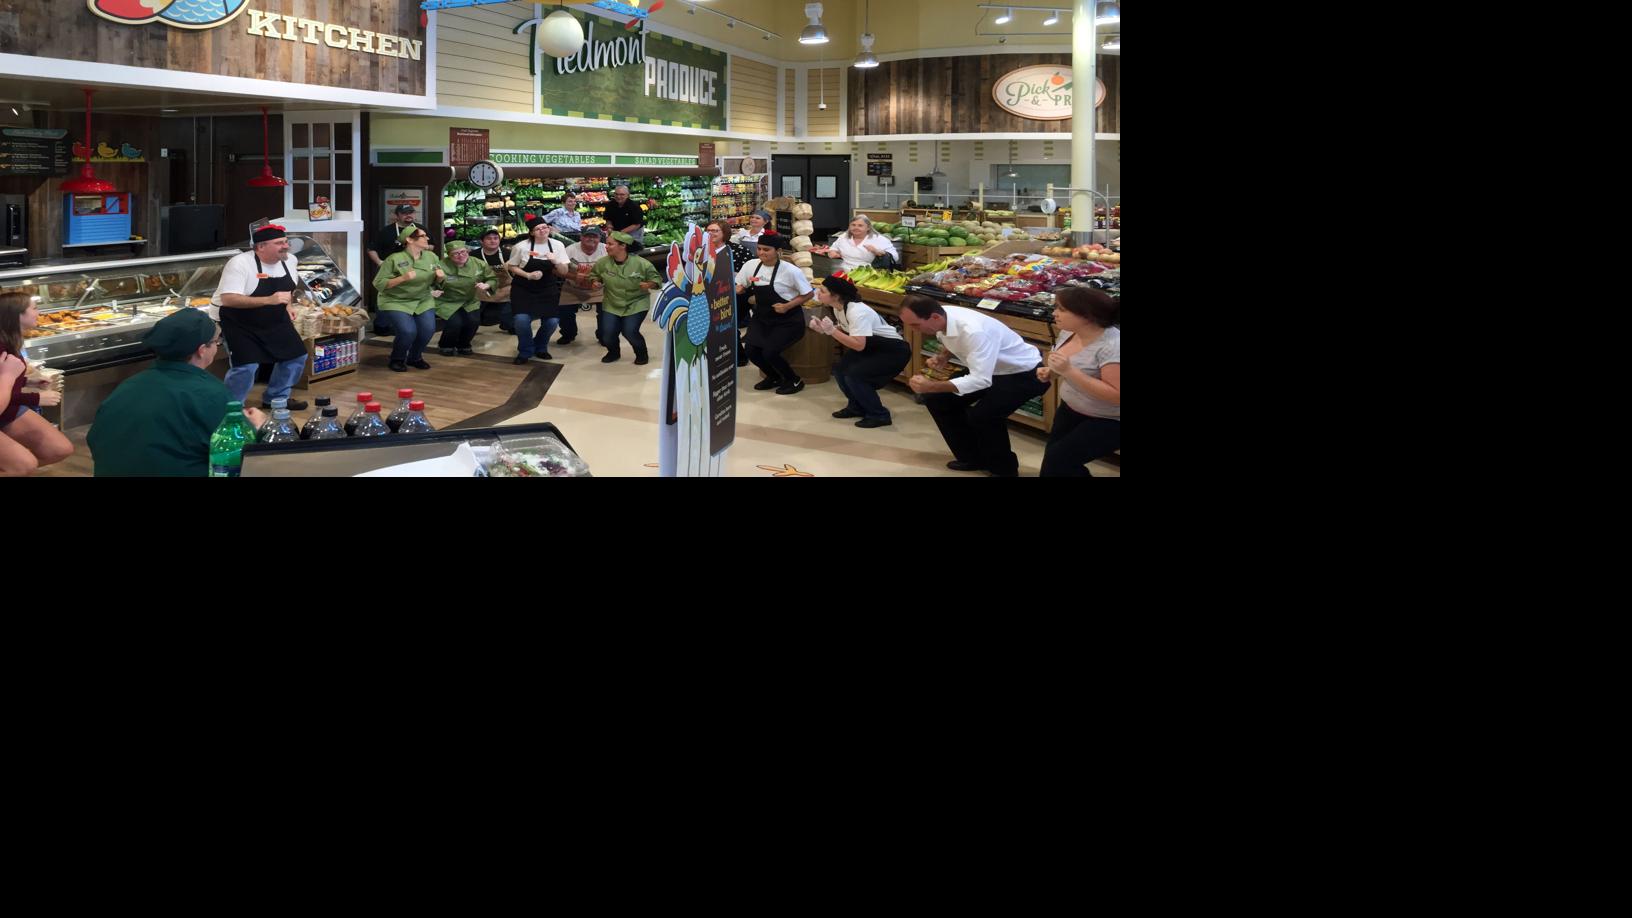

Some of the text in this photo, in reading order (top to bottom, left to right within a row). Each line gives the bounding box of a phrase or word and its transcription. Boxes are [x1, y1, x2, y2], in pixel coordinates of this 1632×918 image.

[247, 8, 423, 61] KITCHEN
[644, 55, 718, 107] PRODUCE
[1005, 79, 1050, 106] Pick
[489, 153, 596, 164] COOKING VEGETABLES
[635, 156, 696, 166] SALAD VEGETABLES
